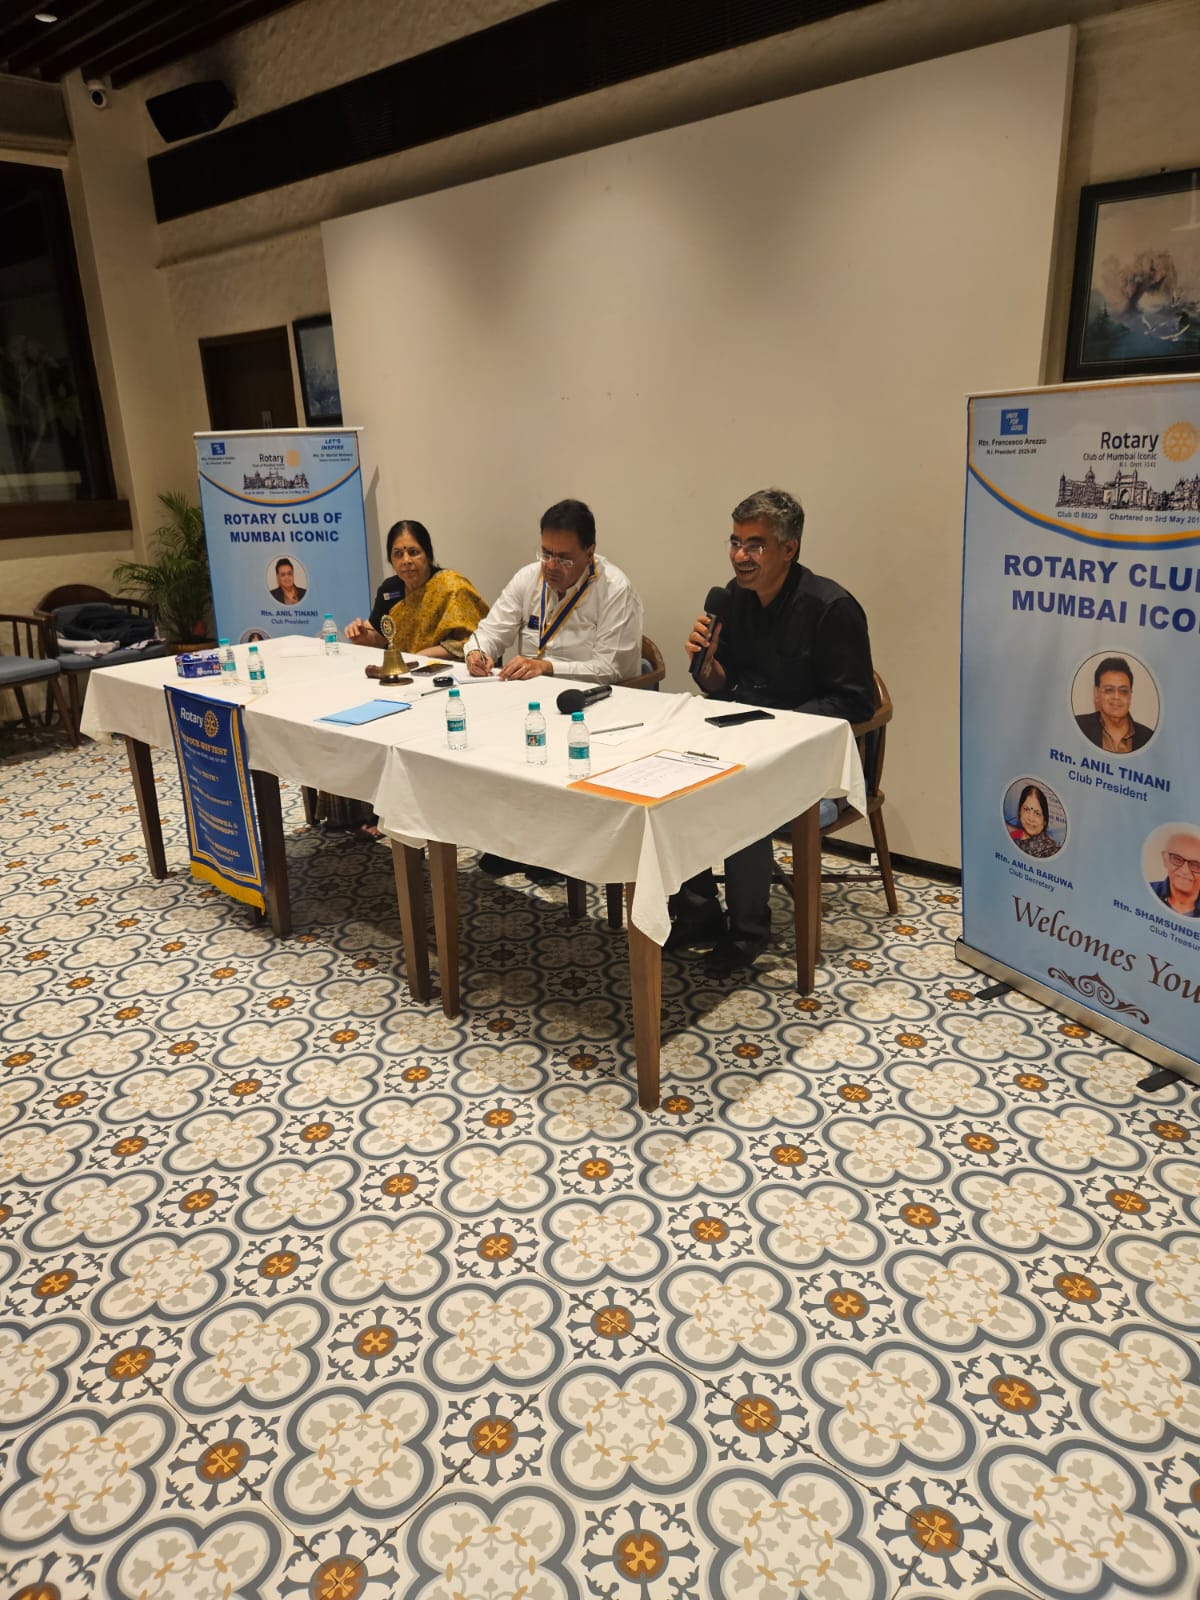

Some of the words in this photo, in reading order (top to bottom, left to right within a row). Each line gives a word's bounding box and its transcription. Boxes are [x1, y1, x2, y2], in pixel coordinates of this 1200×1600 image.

[1100, 431, 1160, 452] Rotary
[259, 453, 284, 463] Rotary
[1083, 453, 1097, 461] Club
[1098, 453, 1105, 461] of
[1106, 453, 1136, 461] Mumbai
[224, 513, 277, 525] ROTARY
[282, 513, 319, 524] CLUB
[323, 512, 342, 524] OF
[1109, 513, 1144, 521] Chartered
[1169, 515, 1185, 525] May
[230, 531, 285, 543] MUMBAI
[290, 530, 339, 542] ICONIC
[1004, 554, 1118, 584] ROTARY
[1012, 590, 1128, 624] MUMBAI
[1139, 604, 1200, 634] ICO
[180, 707, 203, 728] Rotary
[1050, 748, 1076, 766] Rtn.
[1080, 756, 1114, 776] ANIL
[1118, 766, 1171, 792] TINANI
[1068, 770, 1094, 786] Club
[1095, 777, 1148, 802] President
[994, 852, 1010, 864] Rtn.
[1012, 860, 1034, 874] AMLA
[1036, 869, 1074, 890] BARUWA
[1009, 868, 1023, 879] Club
[1024, 874, 1056, 892] Secretary
[1113, 899, 1132, 913] Rtn.
[1149, 925, 1168, 938] Club
[1012, 895, 1137, 973] Welcomes
[1147, 953, 1200, 1004] You
